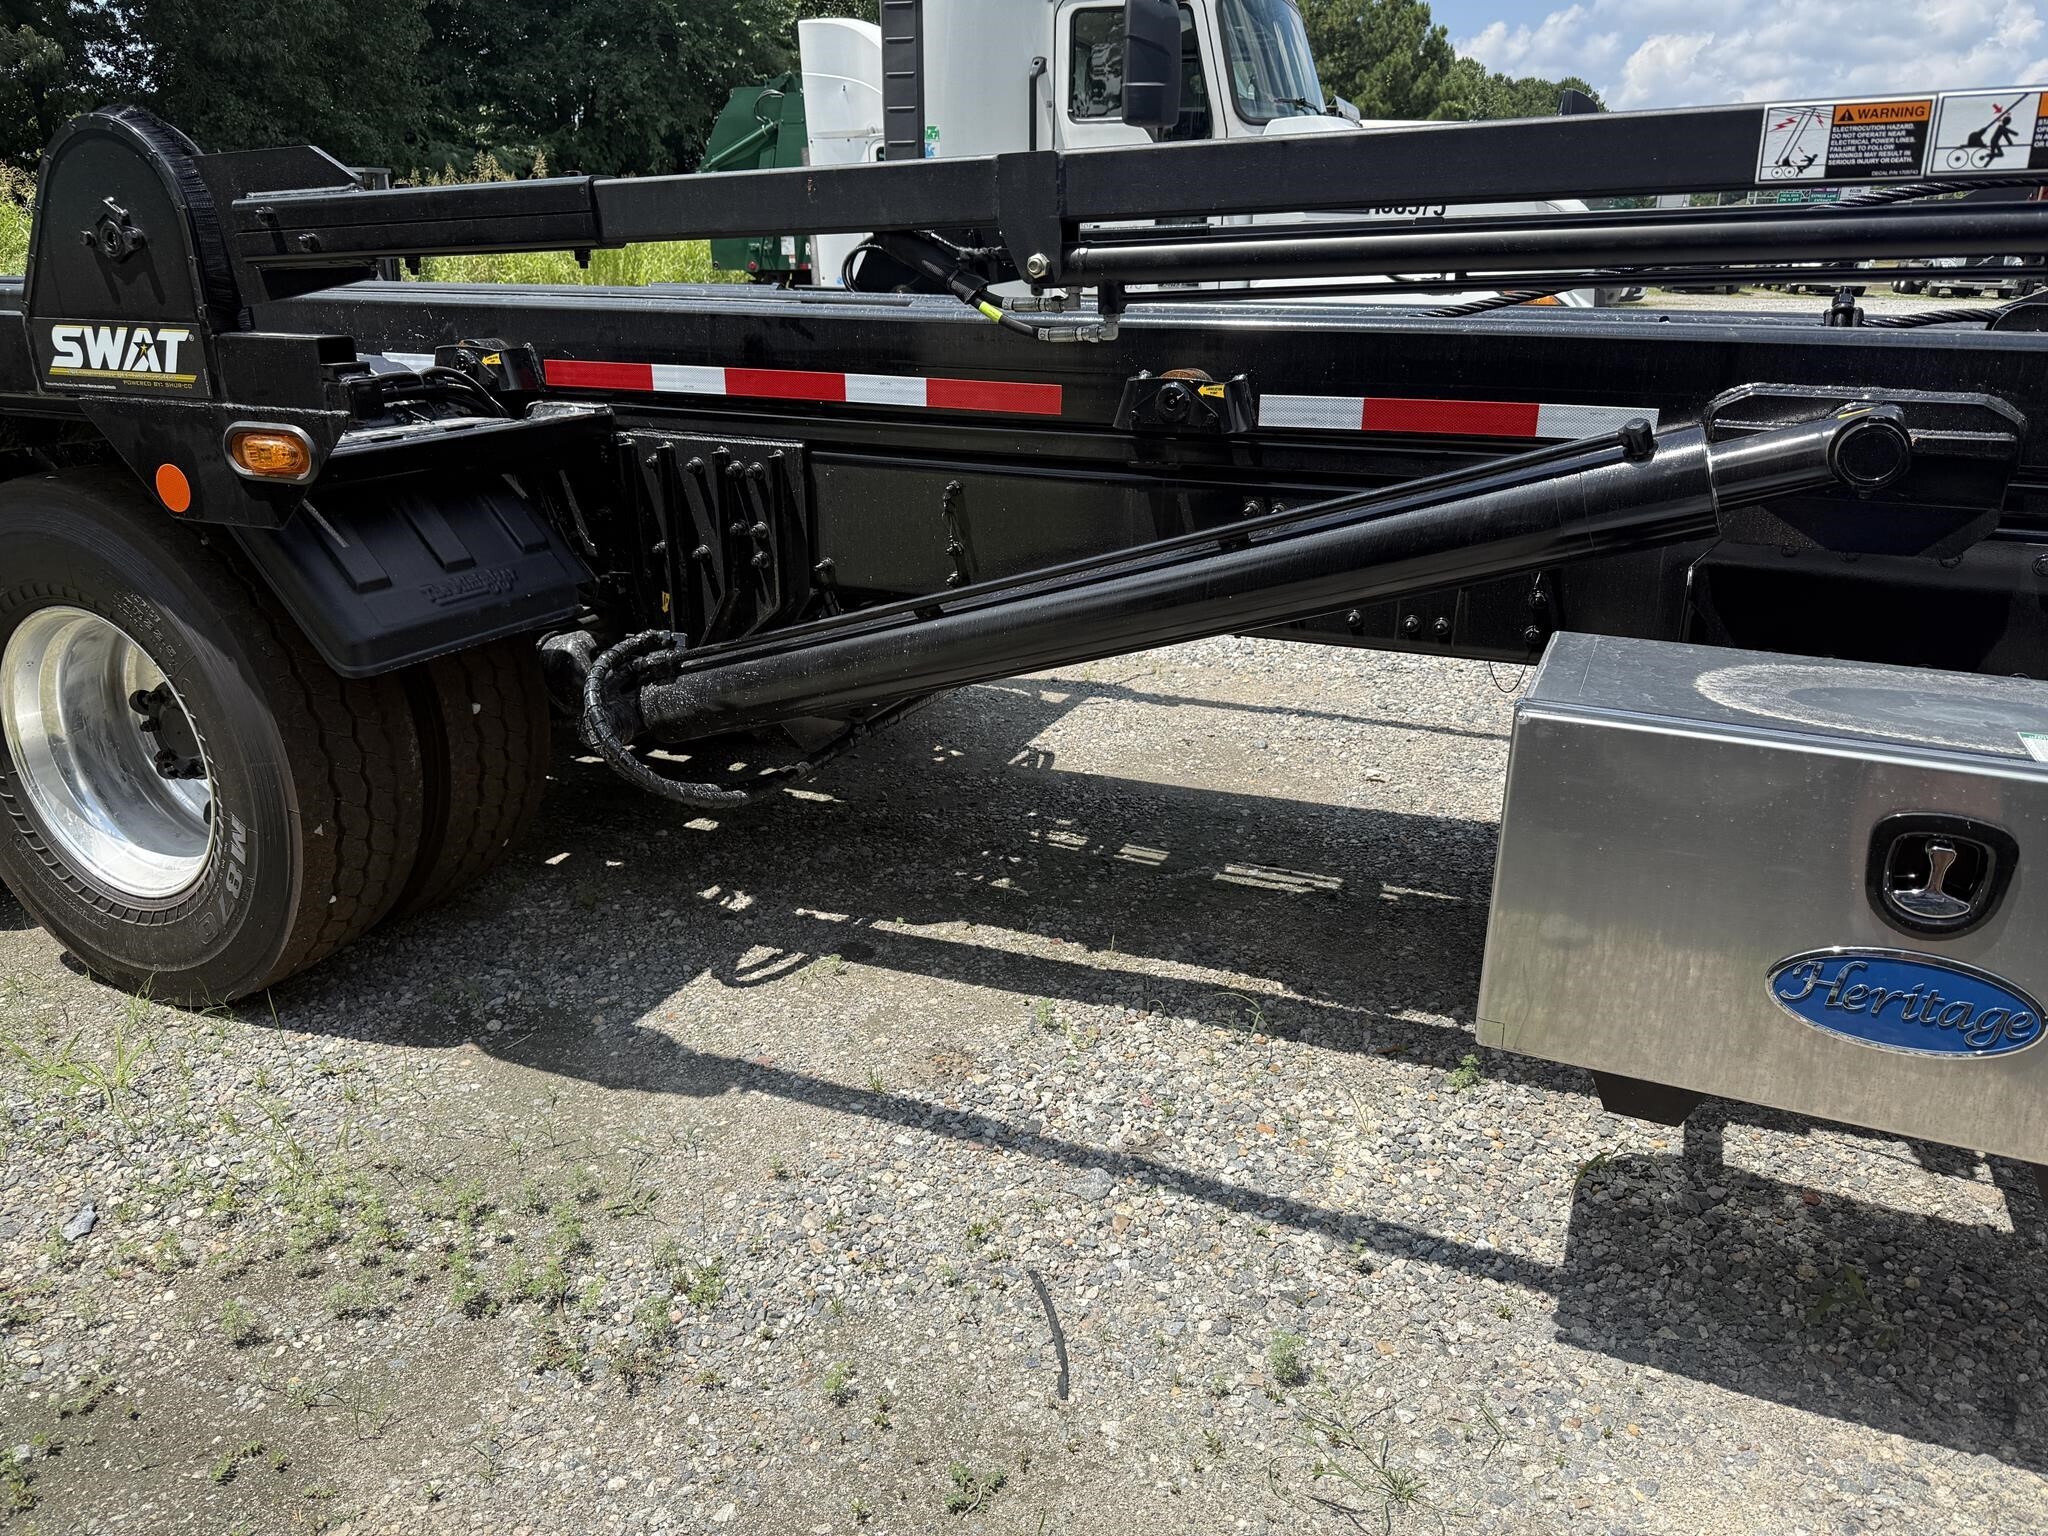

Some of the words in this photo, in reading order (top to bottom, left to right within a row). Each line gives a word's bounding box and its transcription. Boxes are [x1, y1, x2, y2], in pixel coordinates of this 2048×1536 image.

[1857, 106, 1925, 120] WARNING
[1832, 124, 1886, 133] ELECTROCUTION
[1886, 123, 1915, 131] HAZARD.
[1830, 138, 1870, 146] ELECTRICAL
[51, 325, 190, 374] SWAT
[1780, 960, 2035, 1047] Heritage
